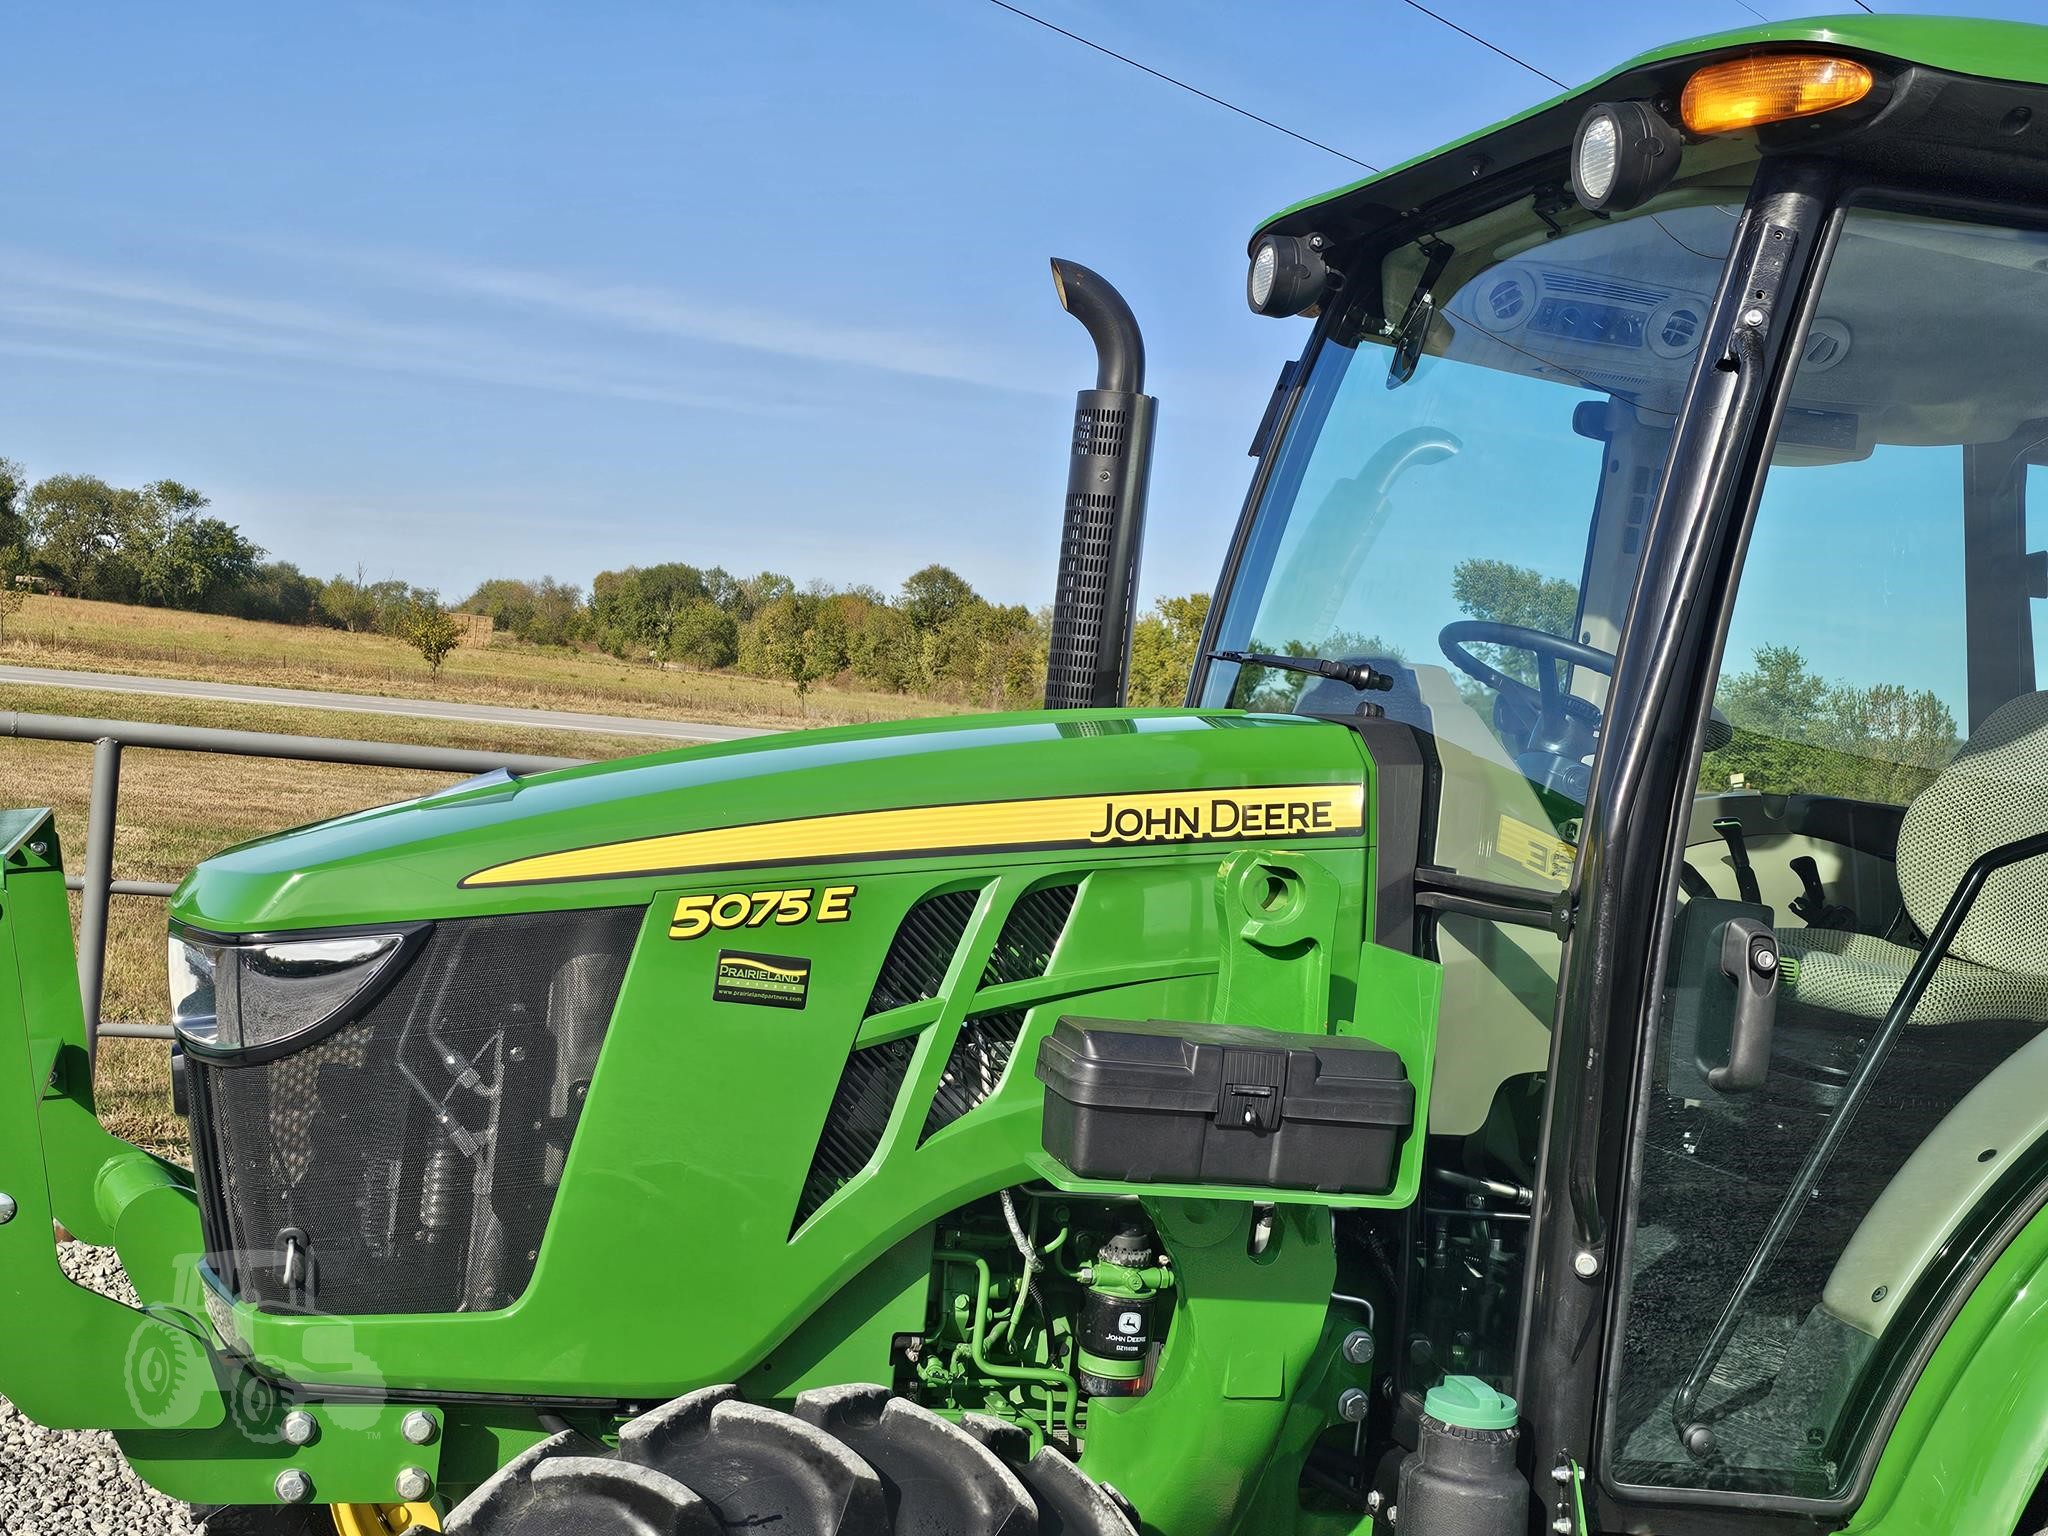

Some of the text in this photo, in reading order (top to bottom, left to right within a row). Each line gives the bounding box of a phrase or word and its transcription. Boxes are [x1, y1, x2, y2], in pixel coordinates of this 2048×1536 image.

[1090, 799, 1332, 838] JOHN DEERE
[668, 885, 858, 940] 5075 E
[719, 965, 801, 983] PRAIRIELAND
[1105, 1333, 1126, 1343] JOHN
